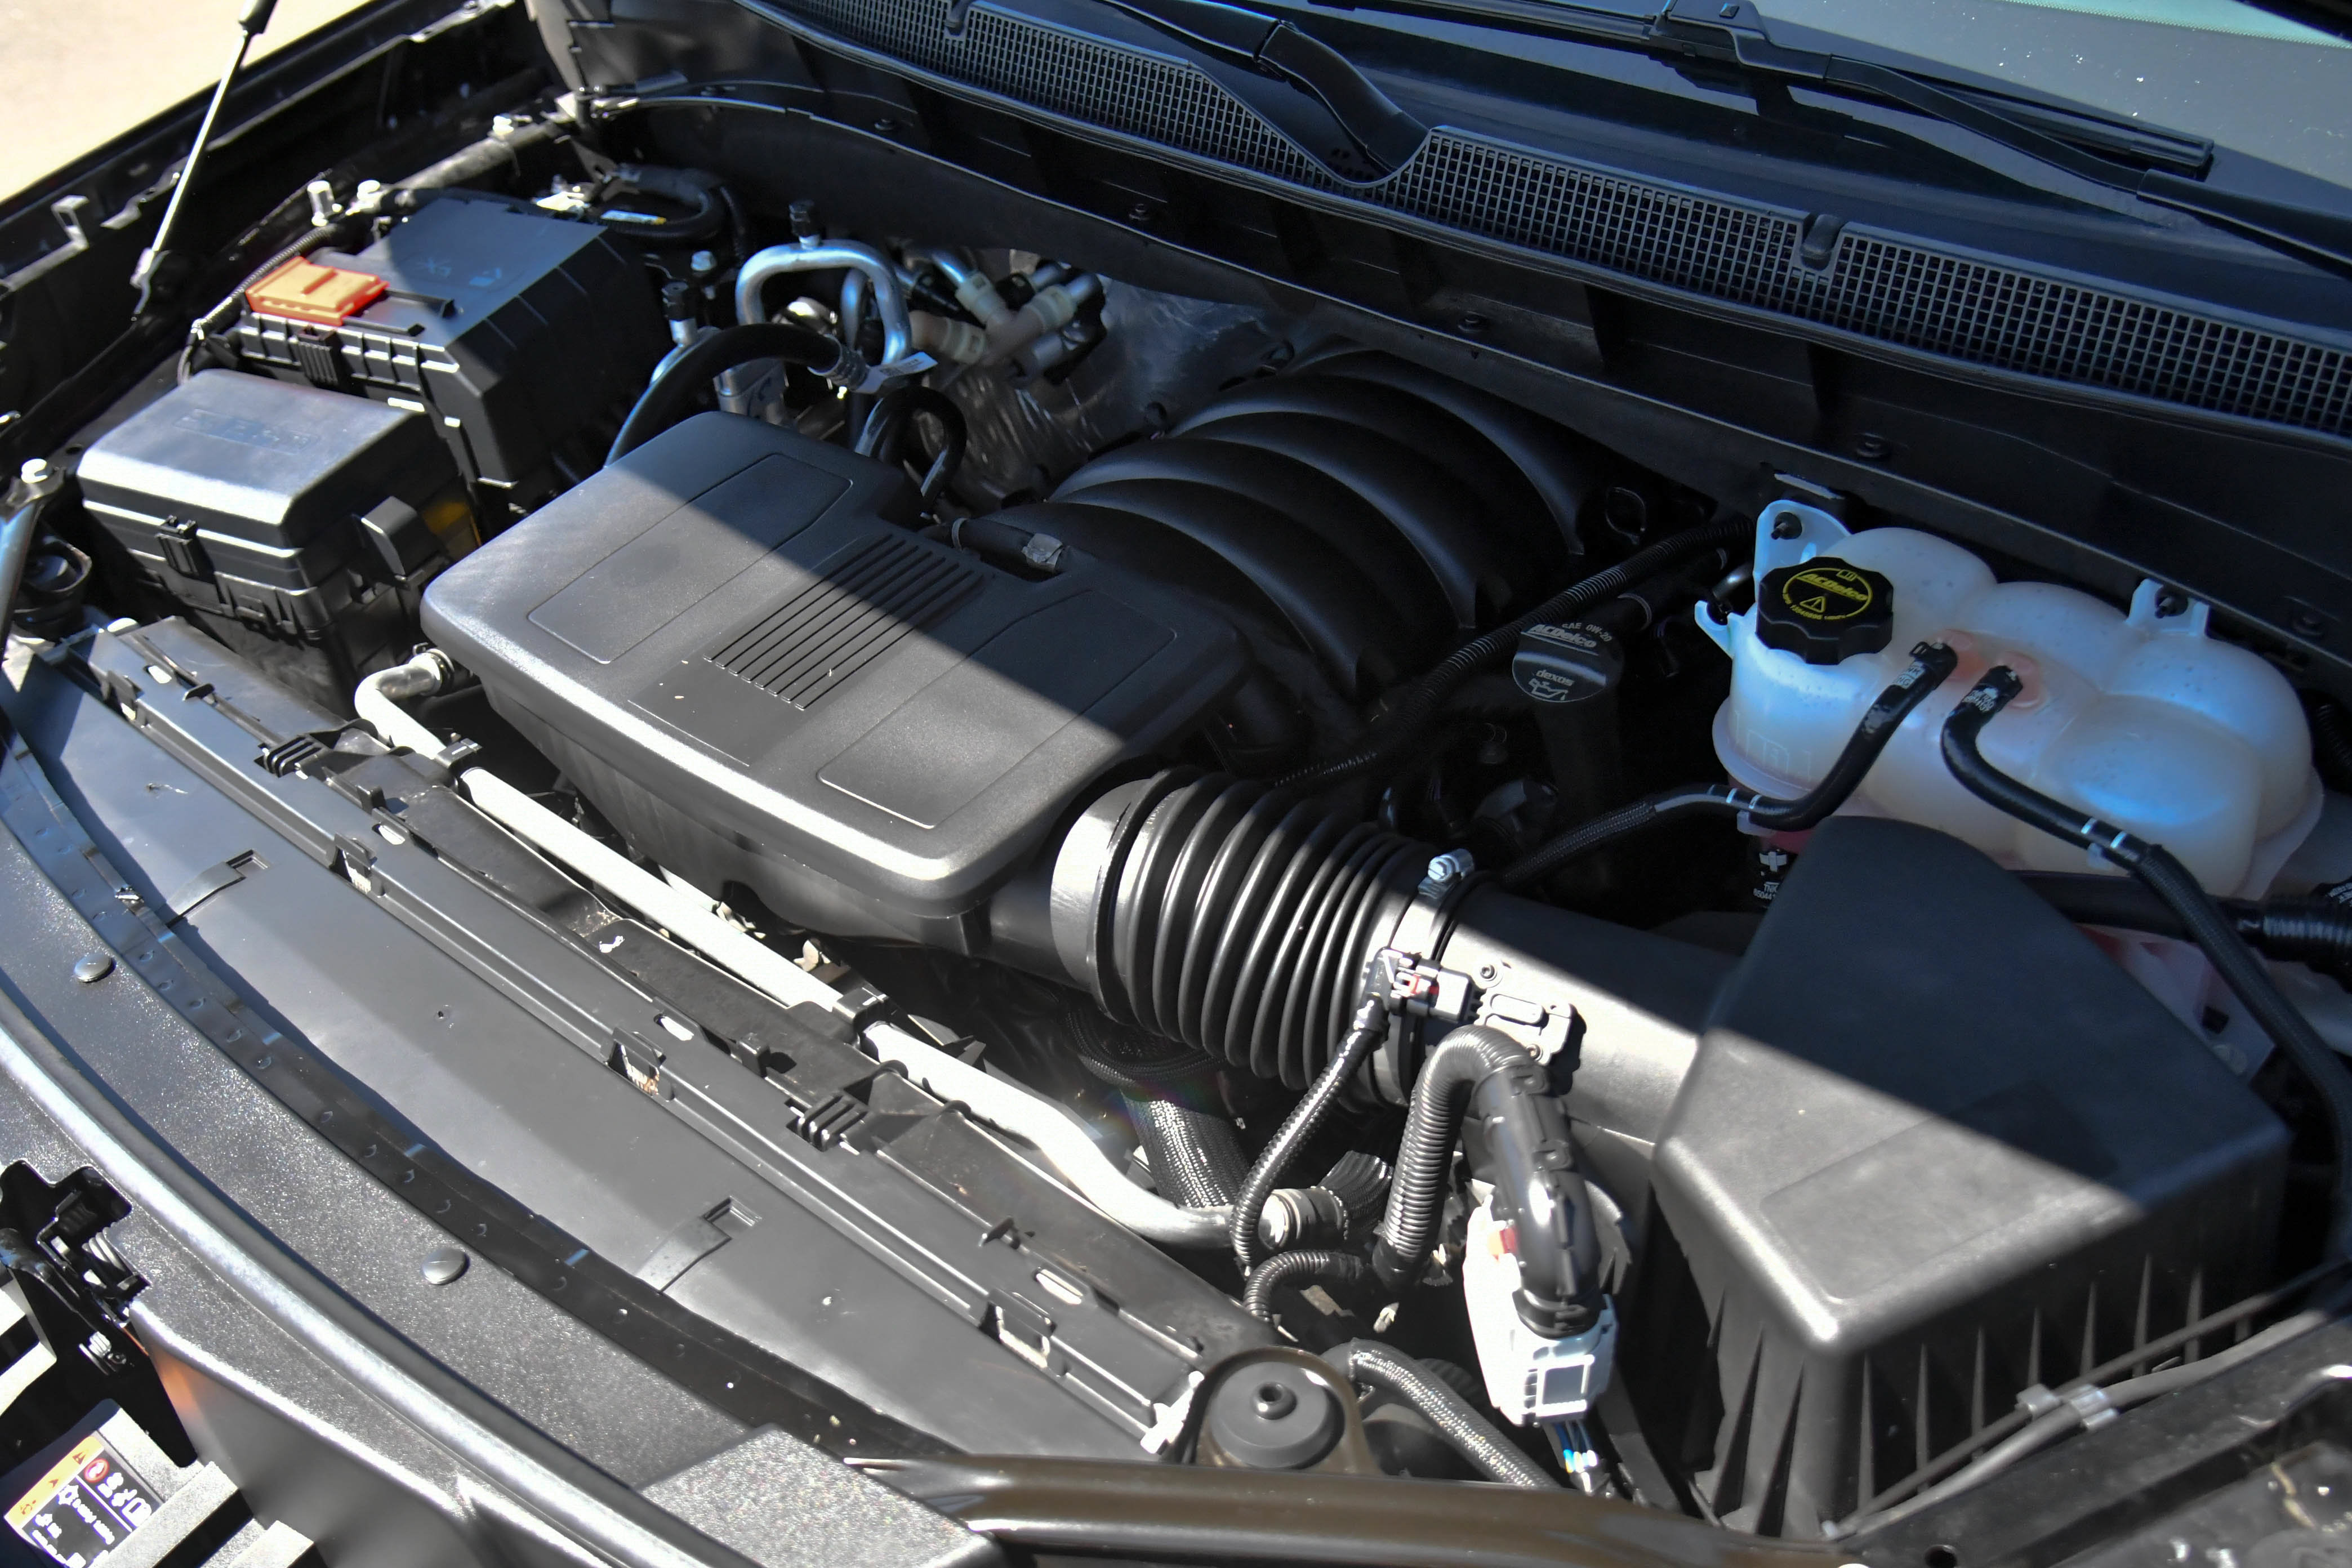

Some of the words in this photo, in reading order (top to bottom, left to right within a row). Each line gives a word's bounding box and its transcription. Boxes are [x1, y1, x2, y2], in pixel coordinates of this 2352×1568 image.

[1798, 573, 1869, 602] ACDelco
[1527, 623, 1597, 648] ACDelco
[1585, 624, 1613, 642] 0W-20
[1535, 669, 1575, 687] dexos
